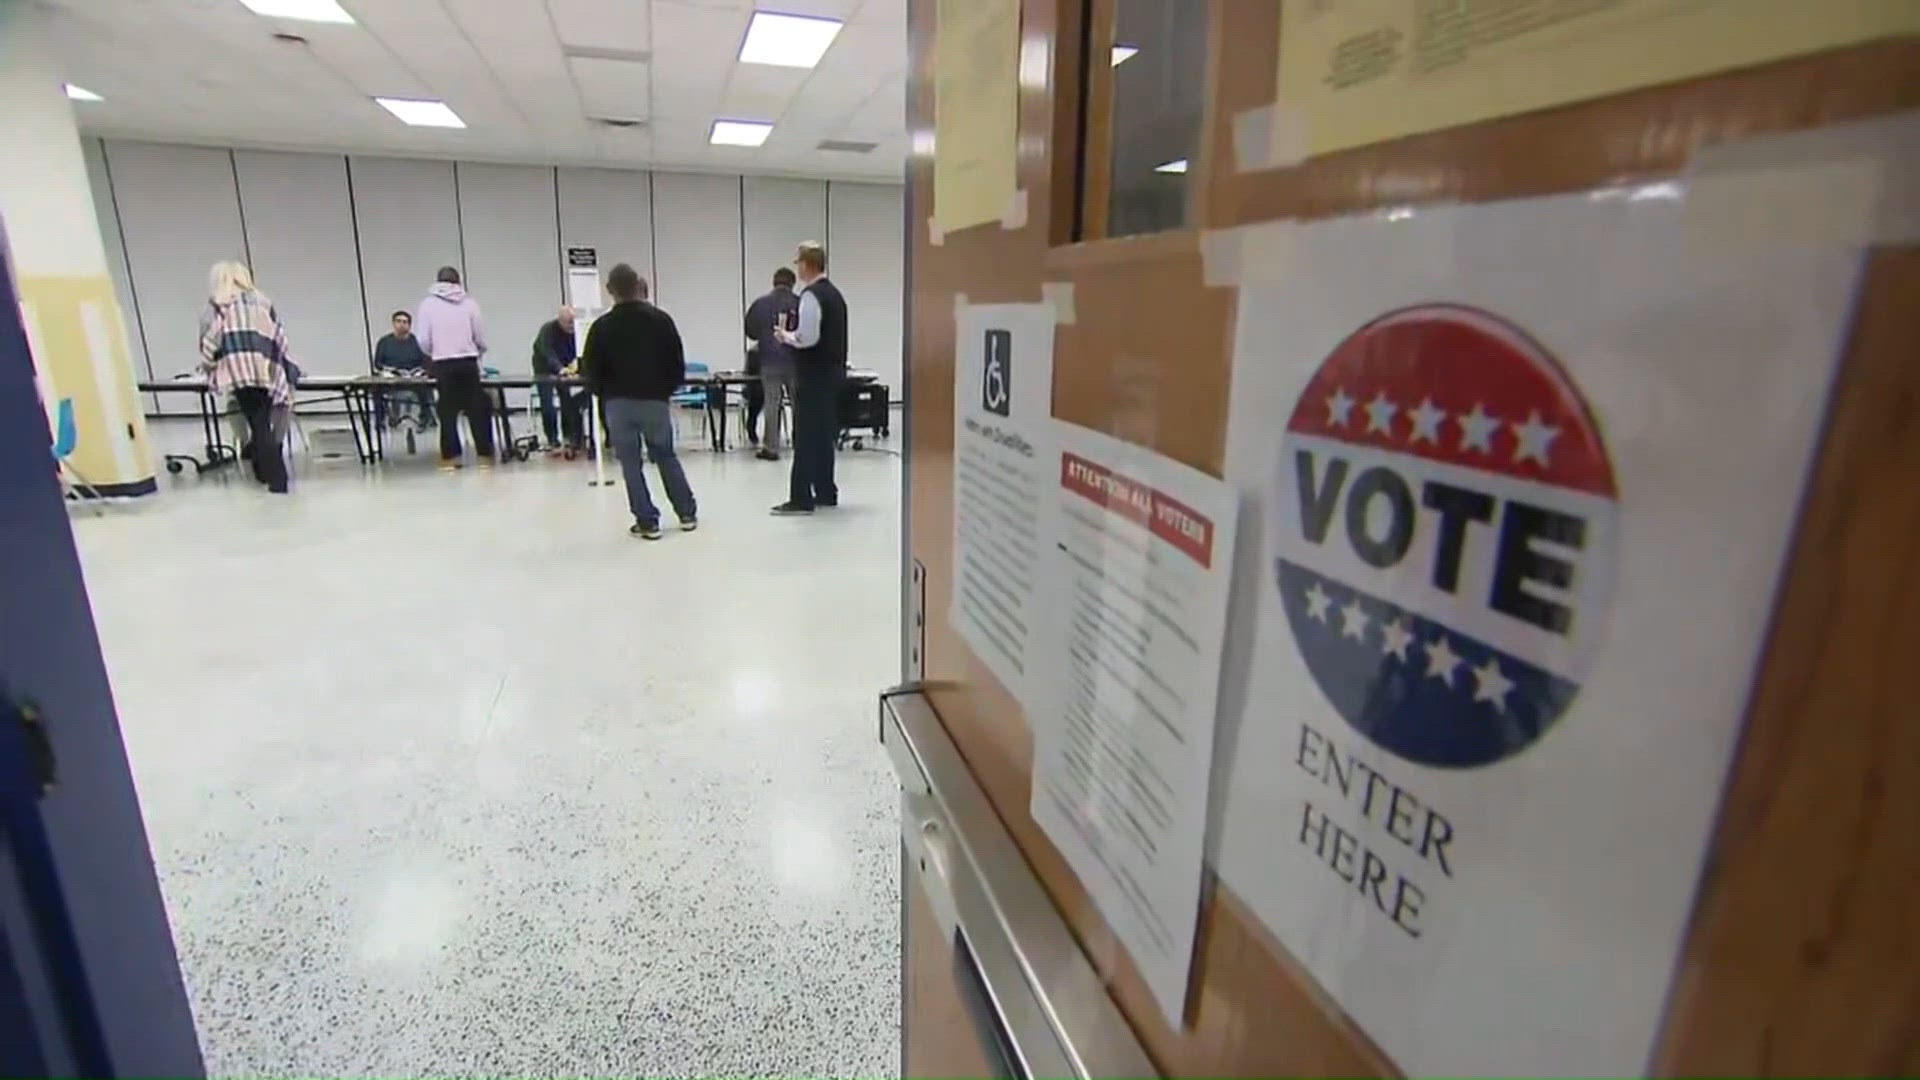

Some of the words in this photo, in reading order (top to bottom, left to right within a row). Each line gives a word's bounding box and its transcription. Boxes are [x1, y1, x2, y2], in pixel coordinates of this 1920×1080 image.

[1295, 450, 1588, 637] VOTE
[1296, 723, 1454, 878] ENTER
[1300, 801, 1426, 938] HERE
